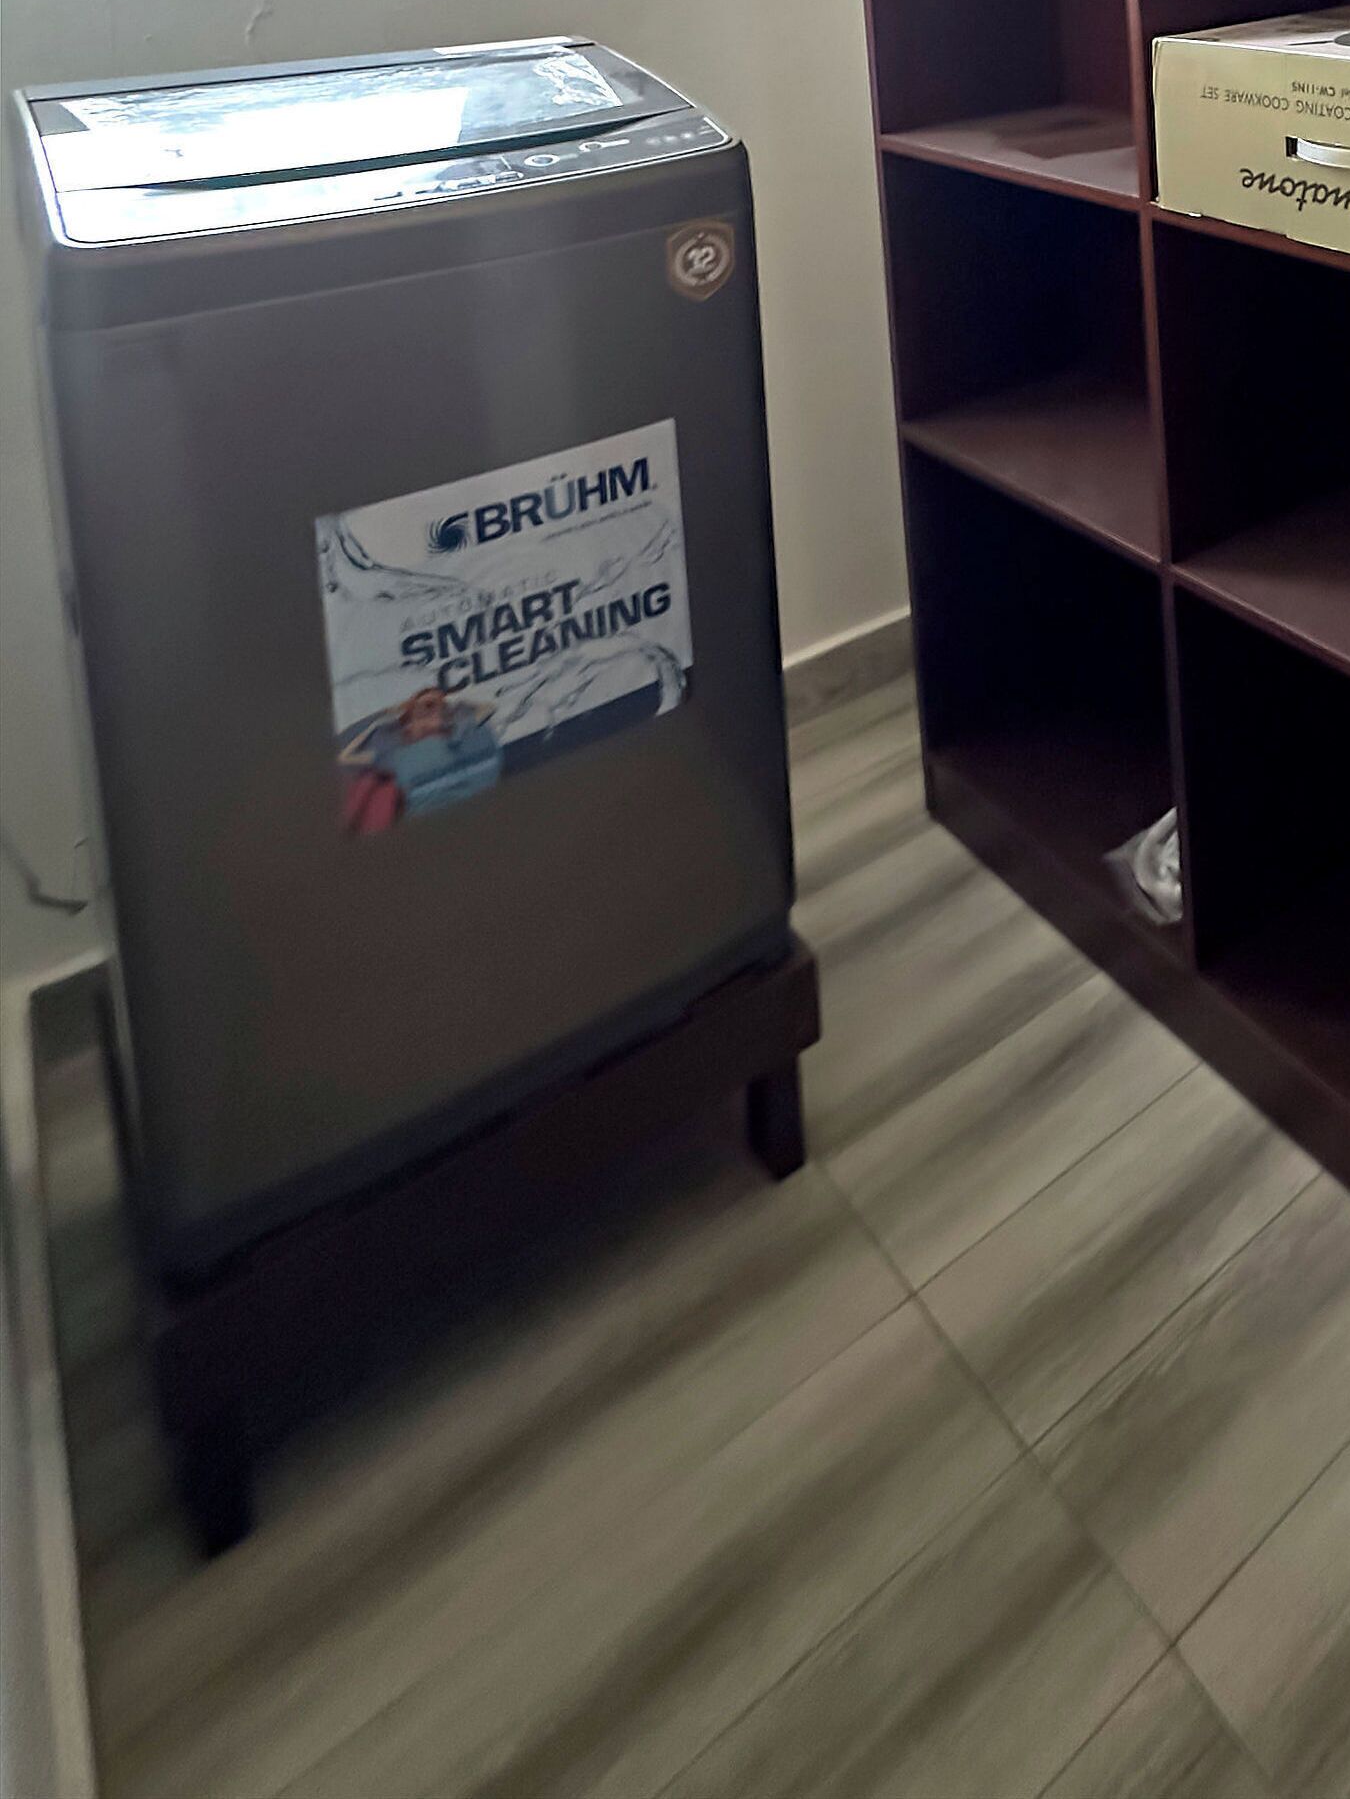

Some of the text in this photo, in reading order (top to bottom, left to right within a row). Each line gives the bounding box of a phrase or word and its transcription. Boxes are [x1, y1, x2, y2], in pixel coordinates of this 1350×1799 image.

[1200, 86, 1219, 100] SET
[1224, 89, 1290, 111] COOKWARE
[474, 457, 650, 545] BRÜHM
[400, 578, 581, 668] SMART
[437, 582, 671, 692] CLEANING
